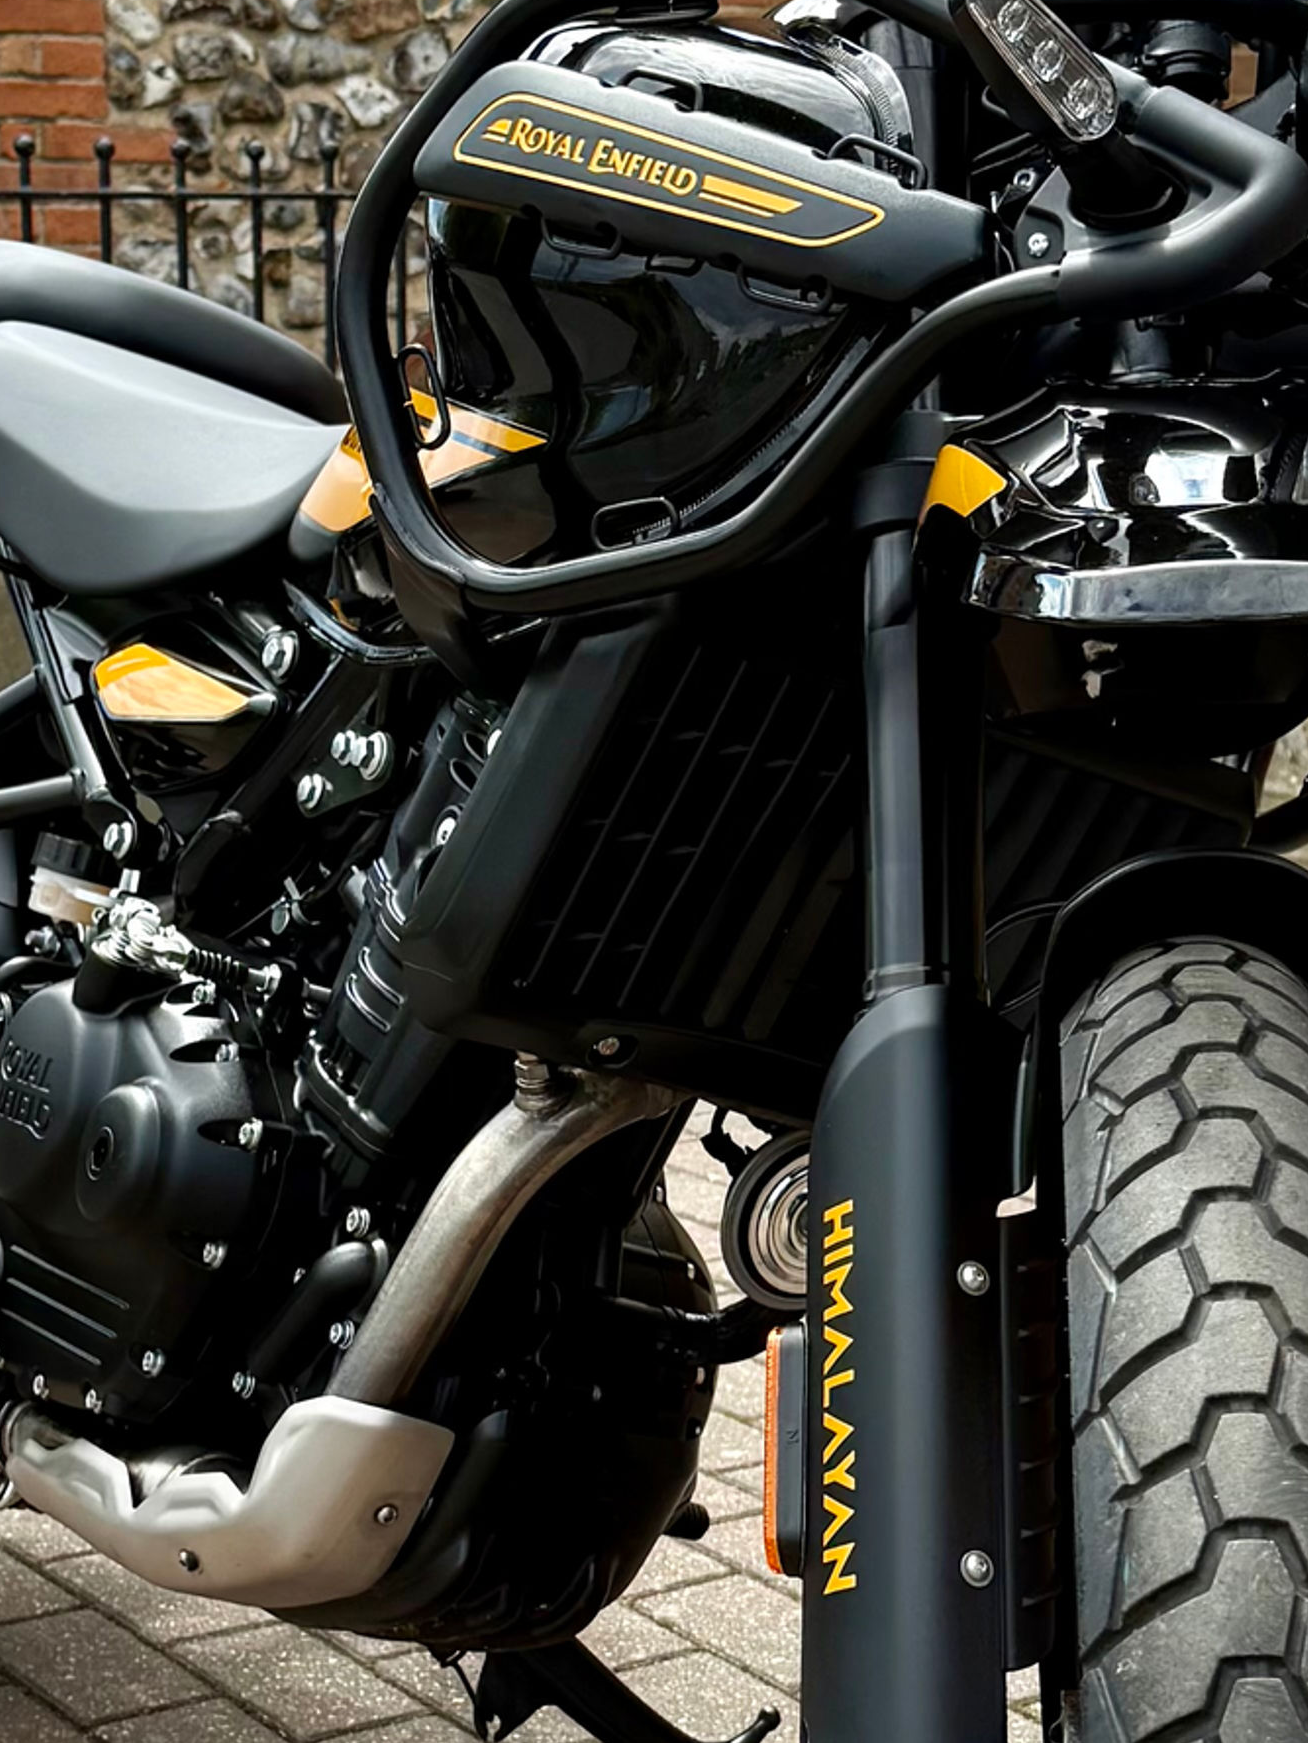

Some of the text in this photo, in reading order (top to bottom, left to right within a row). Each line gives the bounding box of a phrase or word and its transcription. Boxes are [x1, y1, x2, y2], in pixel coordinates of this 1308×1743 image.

[508, 117, 699, 197] ROYAL ENFIELD
[822, 1198, 858, 1596] HIMALAYAN
